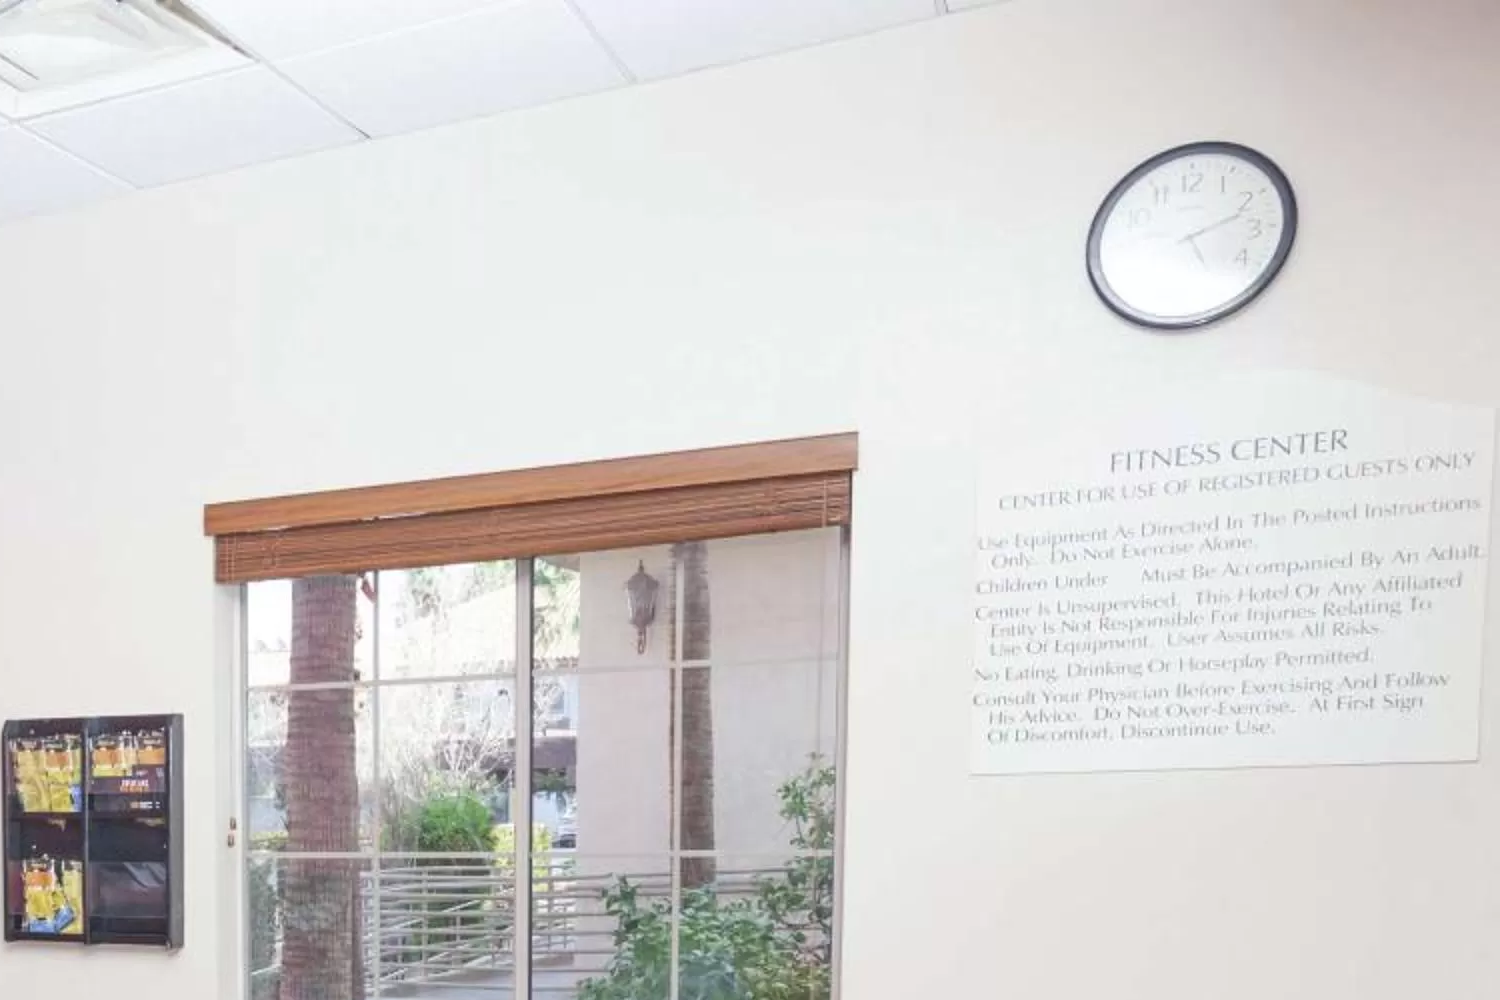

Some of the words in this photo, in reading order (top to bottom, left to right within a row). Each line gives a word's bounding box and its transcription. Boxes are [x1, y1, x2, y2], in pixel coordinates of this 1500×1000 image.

[1154, 184, 1169, 204] 11
[1180, 172, 1204, 193] 12
[1239, 191, 1254, 212] 2
[1247, 218, 1262, 240] 3
[1234, 248, 1250, 266] 4
[1110, 443, 1221, 473] FITNESS
[1231, 429, 1349, 461] CENTER
[999, 490, 1072, 511] CENTER
[1077, 486, 1116, 504] FOR
[1121, 481, 1158, 500] USE
[1163, 479, 1190, 496] OF
[1198, 466, 1320, 493] REGISTERED
[1326, 457, 1408, 481] GUESTS
[1415, 451, 1476, 473] ONLY
[1015, 525, 1108, 551] Equipment
[1113, 524, 1135, 540] As
[1141, 516, 1220, 538] Directed
[1227, 515, 1244, 530] In
[1252, 511, 1286, 528] The
[1293, 504, 1359, 528] Posted
[1365, 496, 1482, 520] Instructions
[1050, 549, 1078, 564] Do
[1084, 546, 1115, 561] Not
[1122, 542, 1194, 561] Exercise
[975, 576, 1049, 595] Children
[1055, 571, 1109, 590] Under
[1140, 566, 1186, 583] Must
[1192, 563, 1216, 580] Be
[1222, 551, 1354, 577] Accompanied
[1360, 551, 1385, 570] By
[1391, 547, 1420, 565] An
[975, 604, 1031, 621] Center
[1038, 602, 1050, 617] Is
[1196, 590, 1230, 606] This
[1236, 583, 1289, 603] Hotel
[1295, 582, 1321, 599] Or
[1328, 580, 1367, 599] Any
[1372, 570, 1464, 594] Affiliated
[990, 620, 1037, 639] Entity
[1043, 619, 1056, 635] Is
[1061, 618, 1092, 633] Not
[1099, 610, 1204, 634] Responsible
[1211, 608, 1240, 625] For
[1246, 605, 1317, 625] Injuries
[1322, 598, 1403, 619] Relating
[1410, 596, 1432, 613] To
[1027, 639, 1048, 654] Of
[1166, 630, 1209, 647] User
[1214, 625, 1294, 643] Assumes
[1300, 621, 1325, 638] All
[1066, 660, 1143, 678] Drinking
[1148, 657, 1173, 674] Or
[1179, 653, 1268, 674] Horseplay
[973, 688, 1036, 706] Consult
[1042, 686, 1080, 704] Your
[1087, 682, 1169, 704] Physician
[1175, 681, 1235, 699] Before
[1240, 675, 1333, 697] Exercising
[1339, 672, 1378, 690] And
[1384, 670, 1452, 689] Follow
[988, 709, 1015, 726] His
[1093, 705, 1121, 722] Do
[1127, 703, 1160, 720] Not
[1308, 695, 1329, 714] At
[1336, 693, 1375, 712] First
[1383, 691, 1424, 713] Sign
[986, 728, 1011, 744] Of
[1120, 722, 1229, 742] Discontinue
